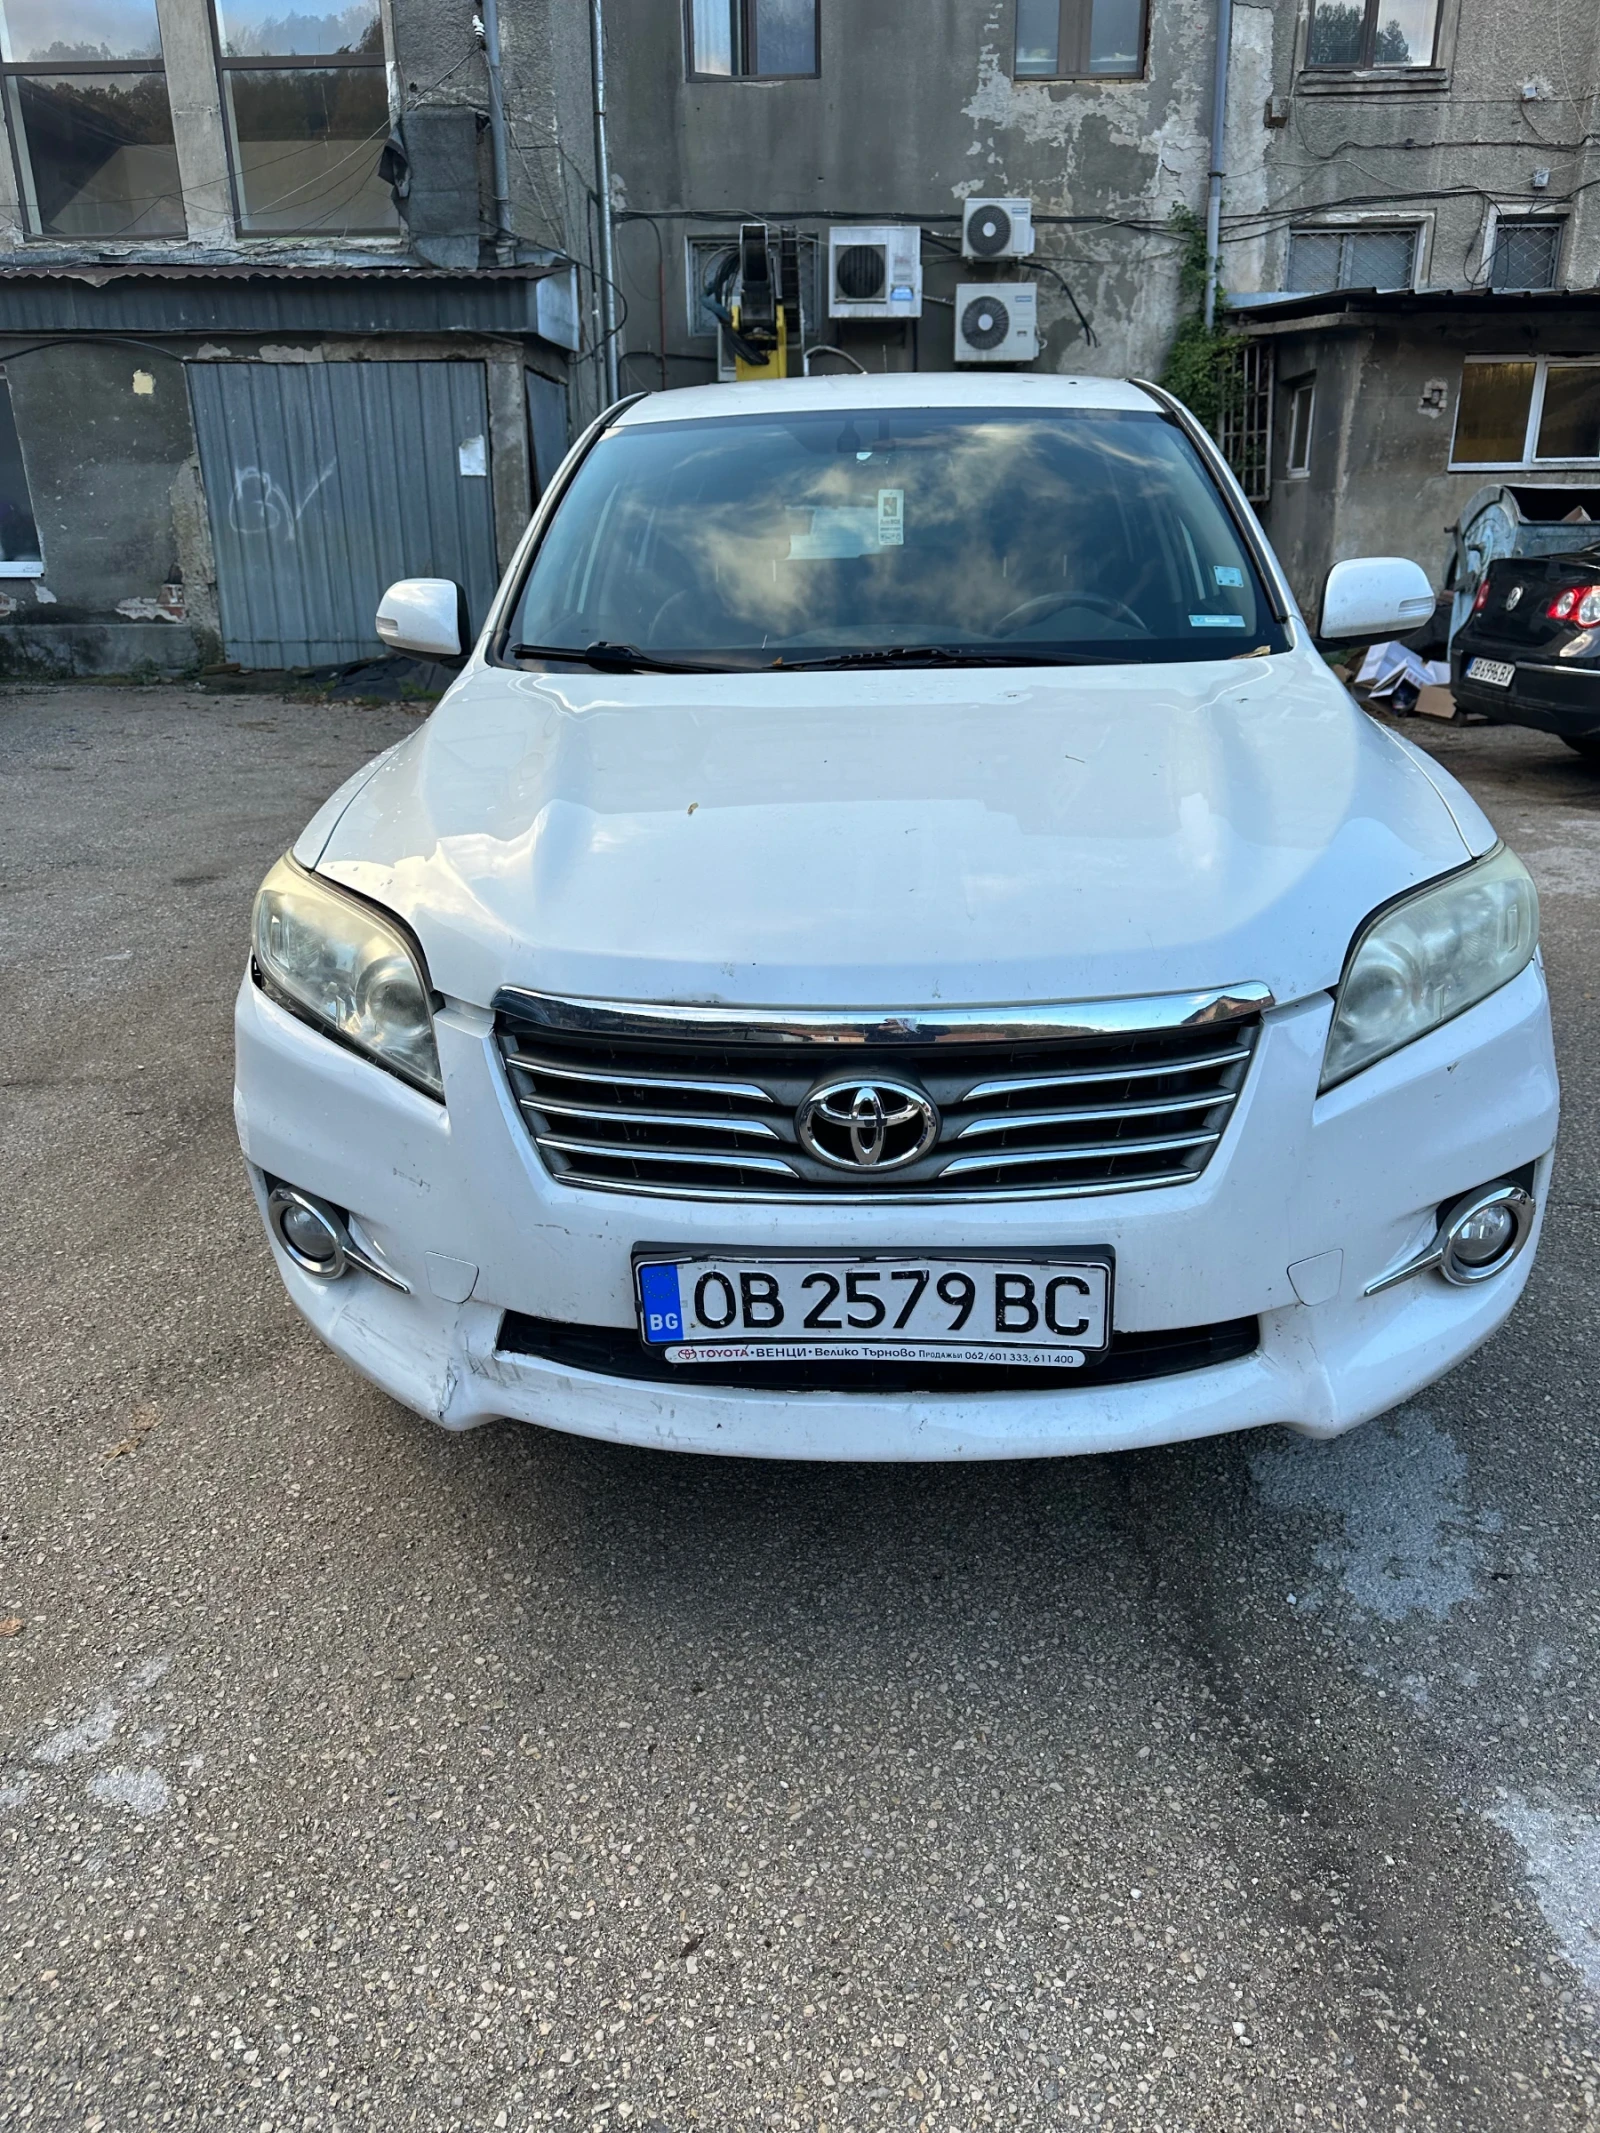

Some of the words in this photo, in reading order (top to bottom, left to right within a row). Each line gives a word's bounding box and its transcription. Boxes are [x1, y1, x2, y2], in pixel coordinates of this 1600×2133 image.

[694, 1271, 784, 1329] OB
[801, 1269, 976, 1330] 2579
[995, 1273, 1090, 1336] BC
[650, 1312, 679, 1330] BG
[699, 1348, 749, 1358] TOYOTA
[814, 1347, 859, 1357] Велико
